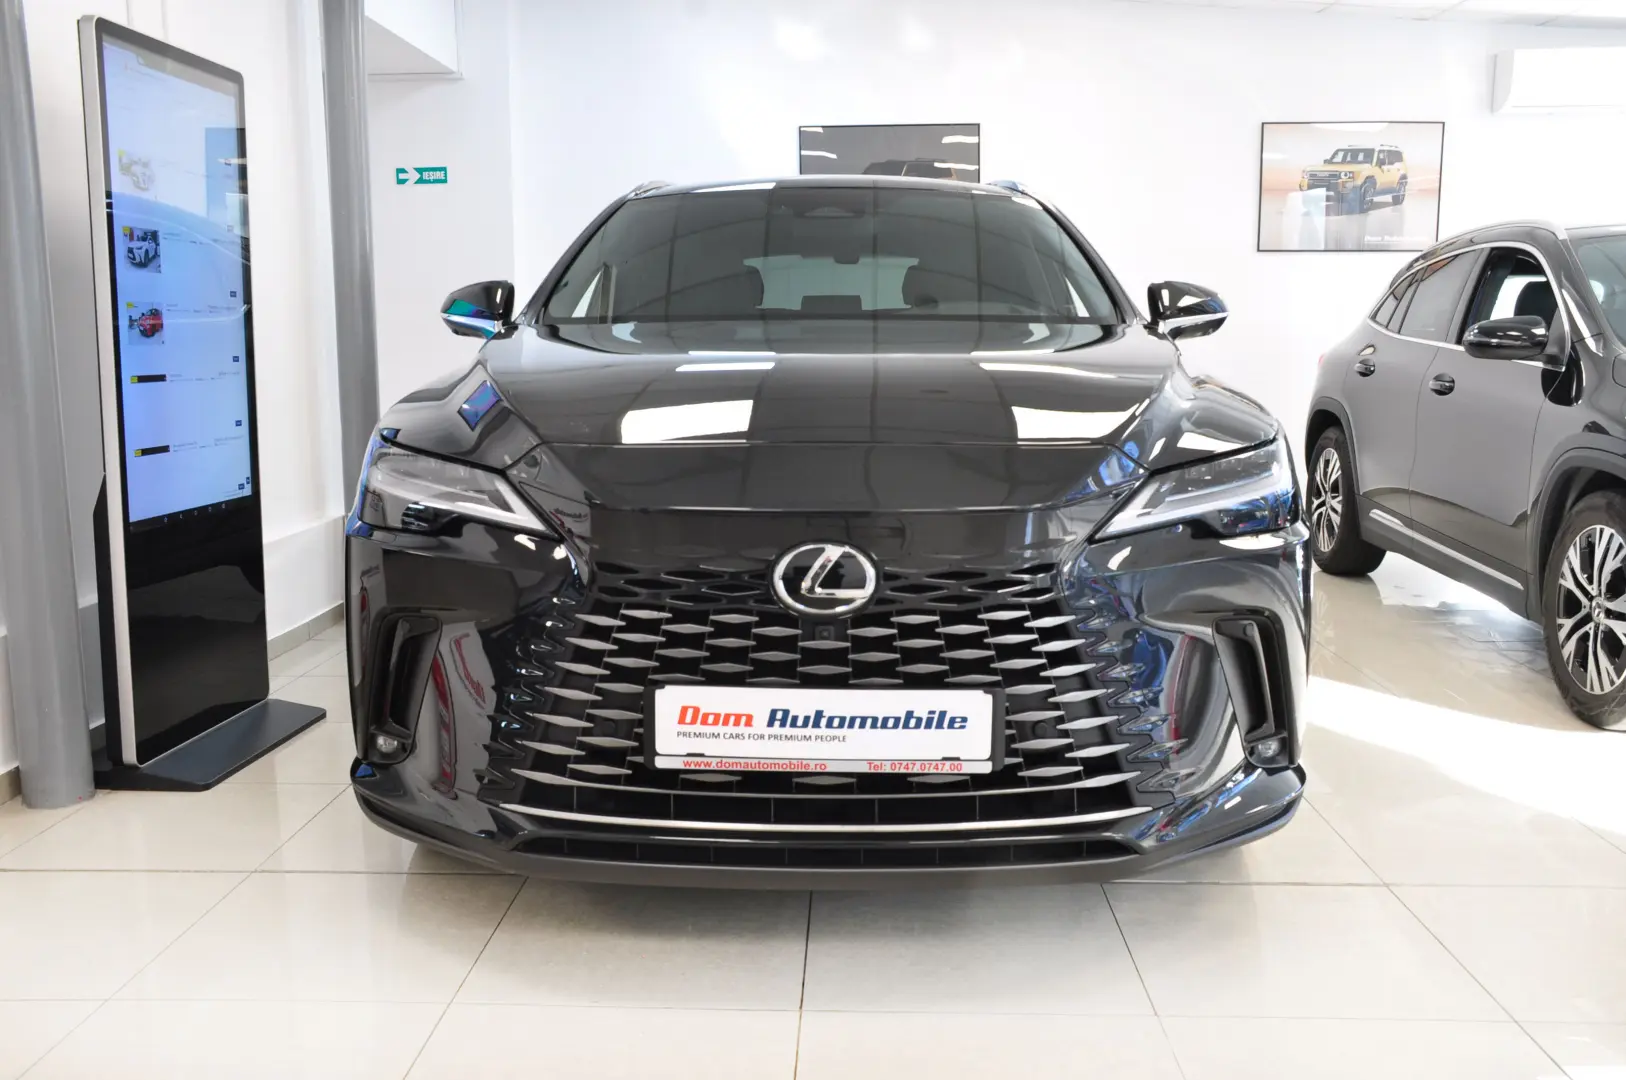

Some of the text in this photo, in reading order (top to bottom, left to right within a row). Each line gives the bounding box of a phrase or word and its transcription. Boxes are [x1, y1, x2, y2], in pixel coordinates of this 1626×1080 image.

[677, 705, 968, 730] Dom Automobile
[676, 731, 847, 743] PREMIUM CARS FOR PREMIUM PEOPLE
[682, 759, 963, 772] www.domautomobile.ro Tel: 0747.0747.00
